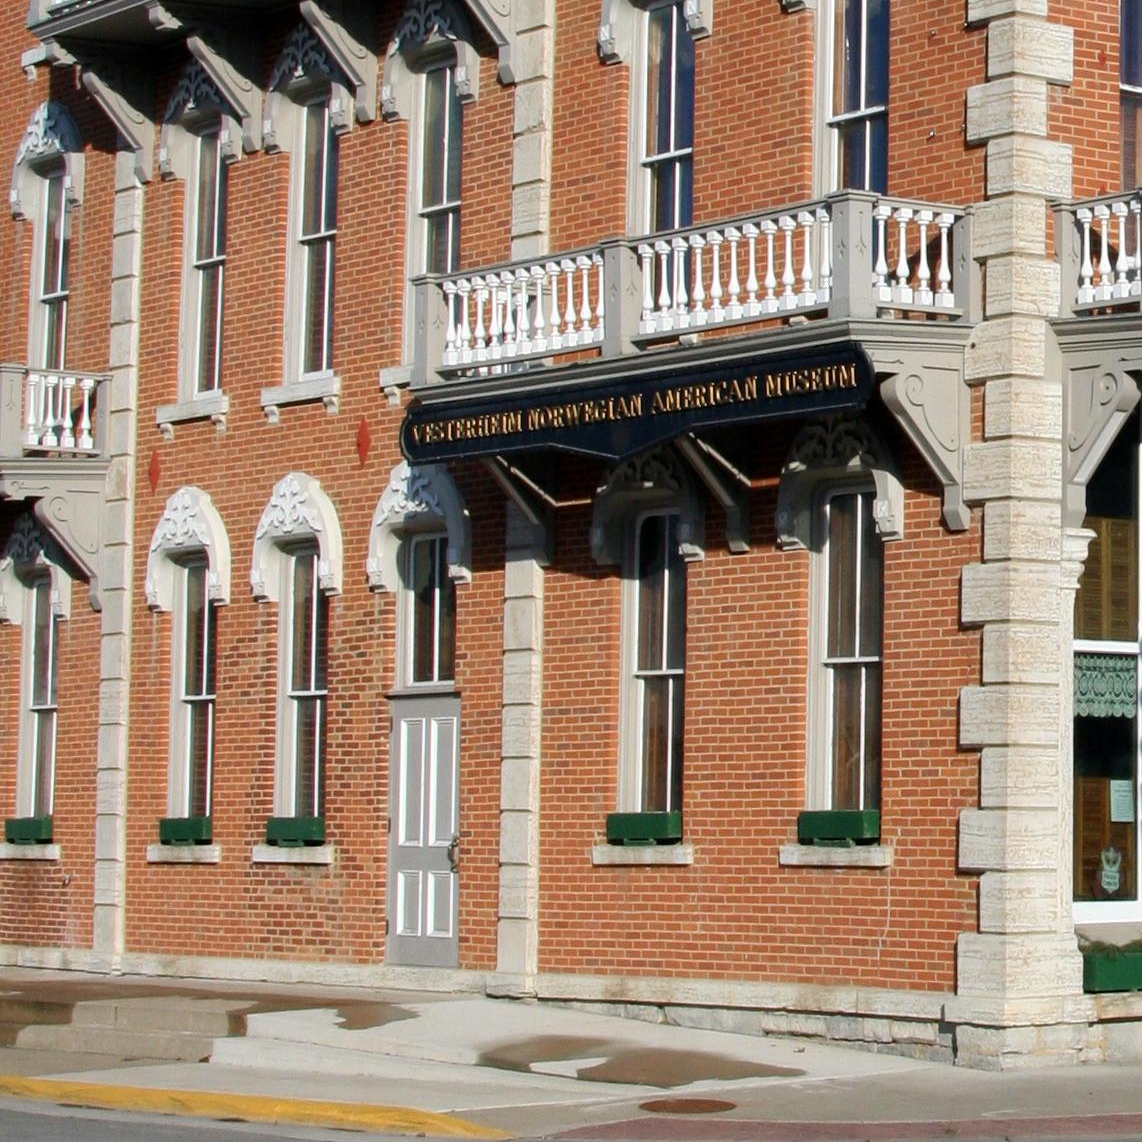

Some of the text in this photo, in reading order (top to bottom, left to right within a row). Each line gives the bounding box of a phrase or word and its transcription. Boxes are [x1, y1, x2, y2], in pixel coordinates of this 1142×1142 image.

[412, 362, 857, 446] VESTERHEIM NORWEGIAN AMERICAN MUSEUM
